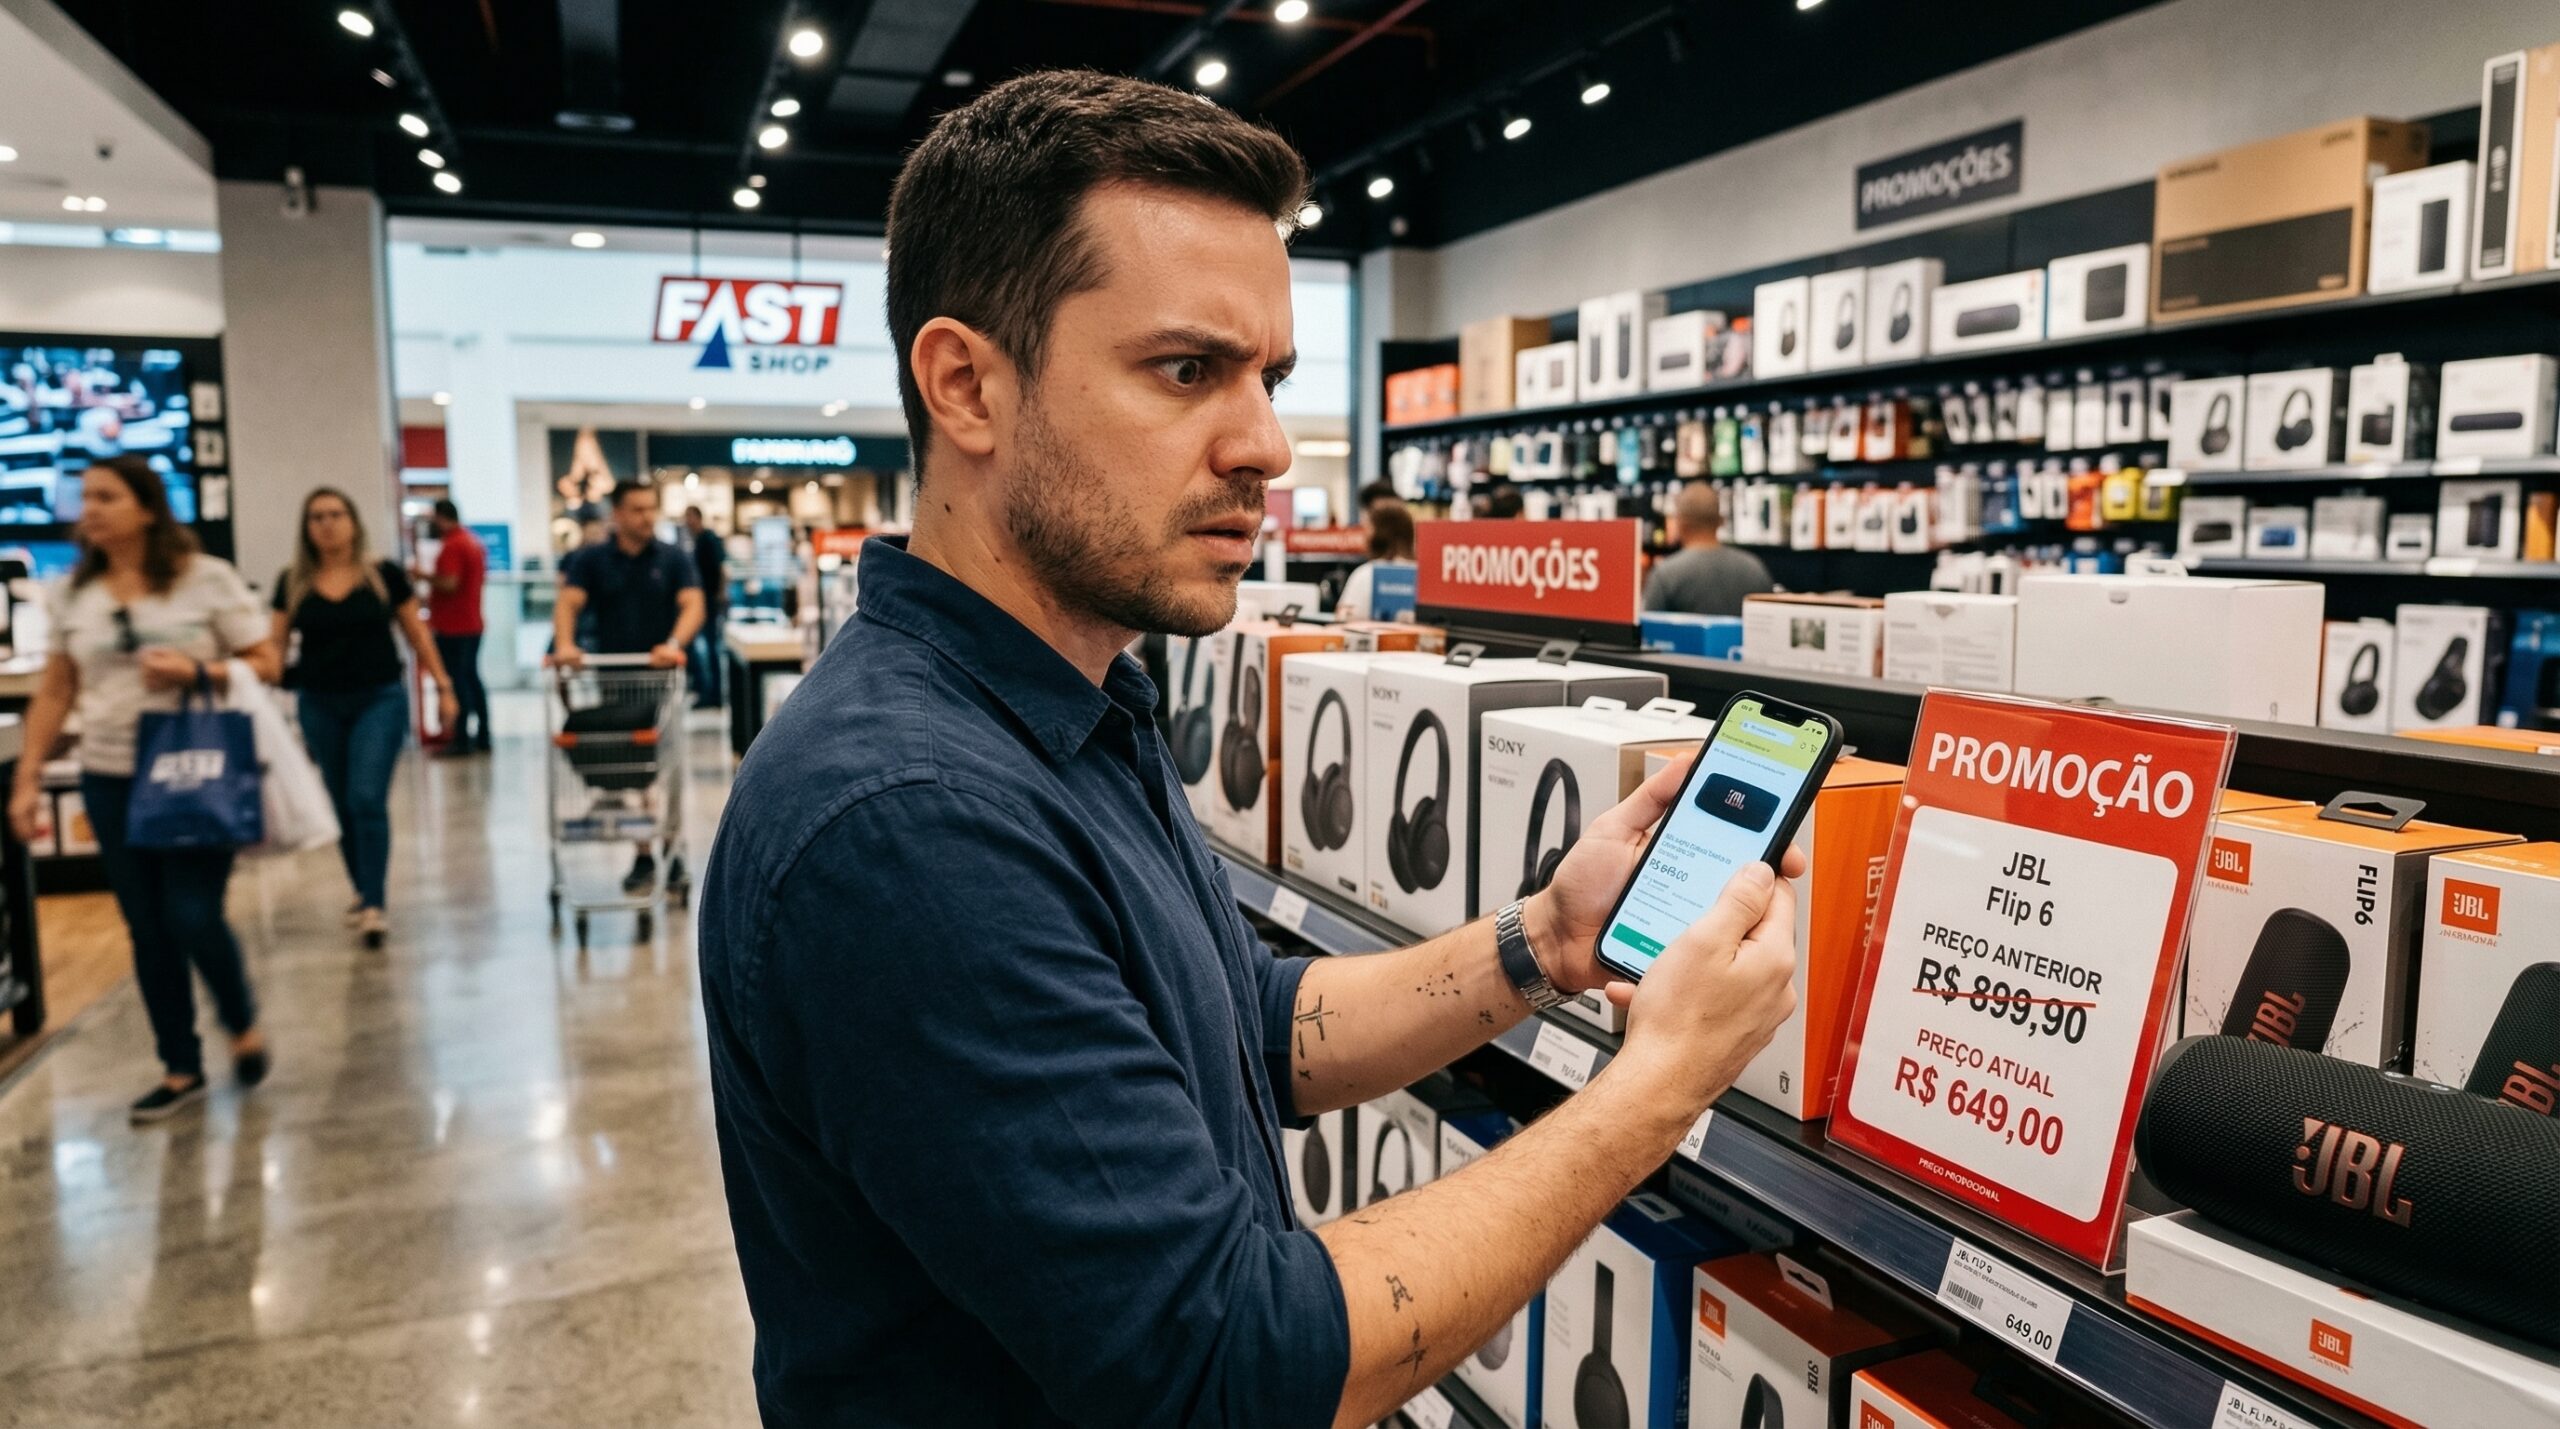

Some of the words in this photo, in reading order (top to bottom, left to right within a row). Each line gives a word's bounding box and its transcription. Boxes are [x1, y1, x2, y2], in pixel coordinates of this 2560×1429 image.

[655, 279, 841, 346] FAST
[750, 354, 830, 373] SHOP
[1441, 537, 1600, 599] PROMOÇÕES
[1488, 735, 1526, 757] SONY
[1927, 731, 2195, 819] PROMOÇÃO
[2002, 851, 2052, 887] JBL
[2214, 847, 2244, 874] JBL
[1985, 885, 2032, 926] Flip
[2037, 900, 2055, 926] 6
[2354, 863, 2378, 925] FLIP6
[2452, 891, 2490, 921] JBL
[1921, 922, 1990, 959] PREÇO
[1991, 944, 2104, 995] ANTERIOR
[1915, 957, 1962, 1006] R$
[1968, 974, 2088, 1045] 899,90
[1916, 1027, 1984, 1068] PREÇO
[1986, 1055, 2056, 1098] ATUAL
[2497, 1060, 2560, 1117] BL
[1893, 1056, 1937, 1107] R$
[1947, 1078, 2065, 1157] 649,00
[2292, 1116, 2414, 1230] JBL
[2005, 1313, 2053, 1351] 649,00
[2318, 1330, 2345, 1356] JBL
[2228, 1396, 2248, 1416] JBL
